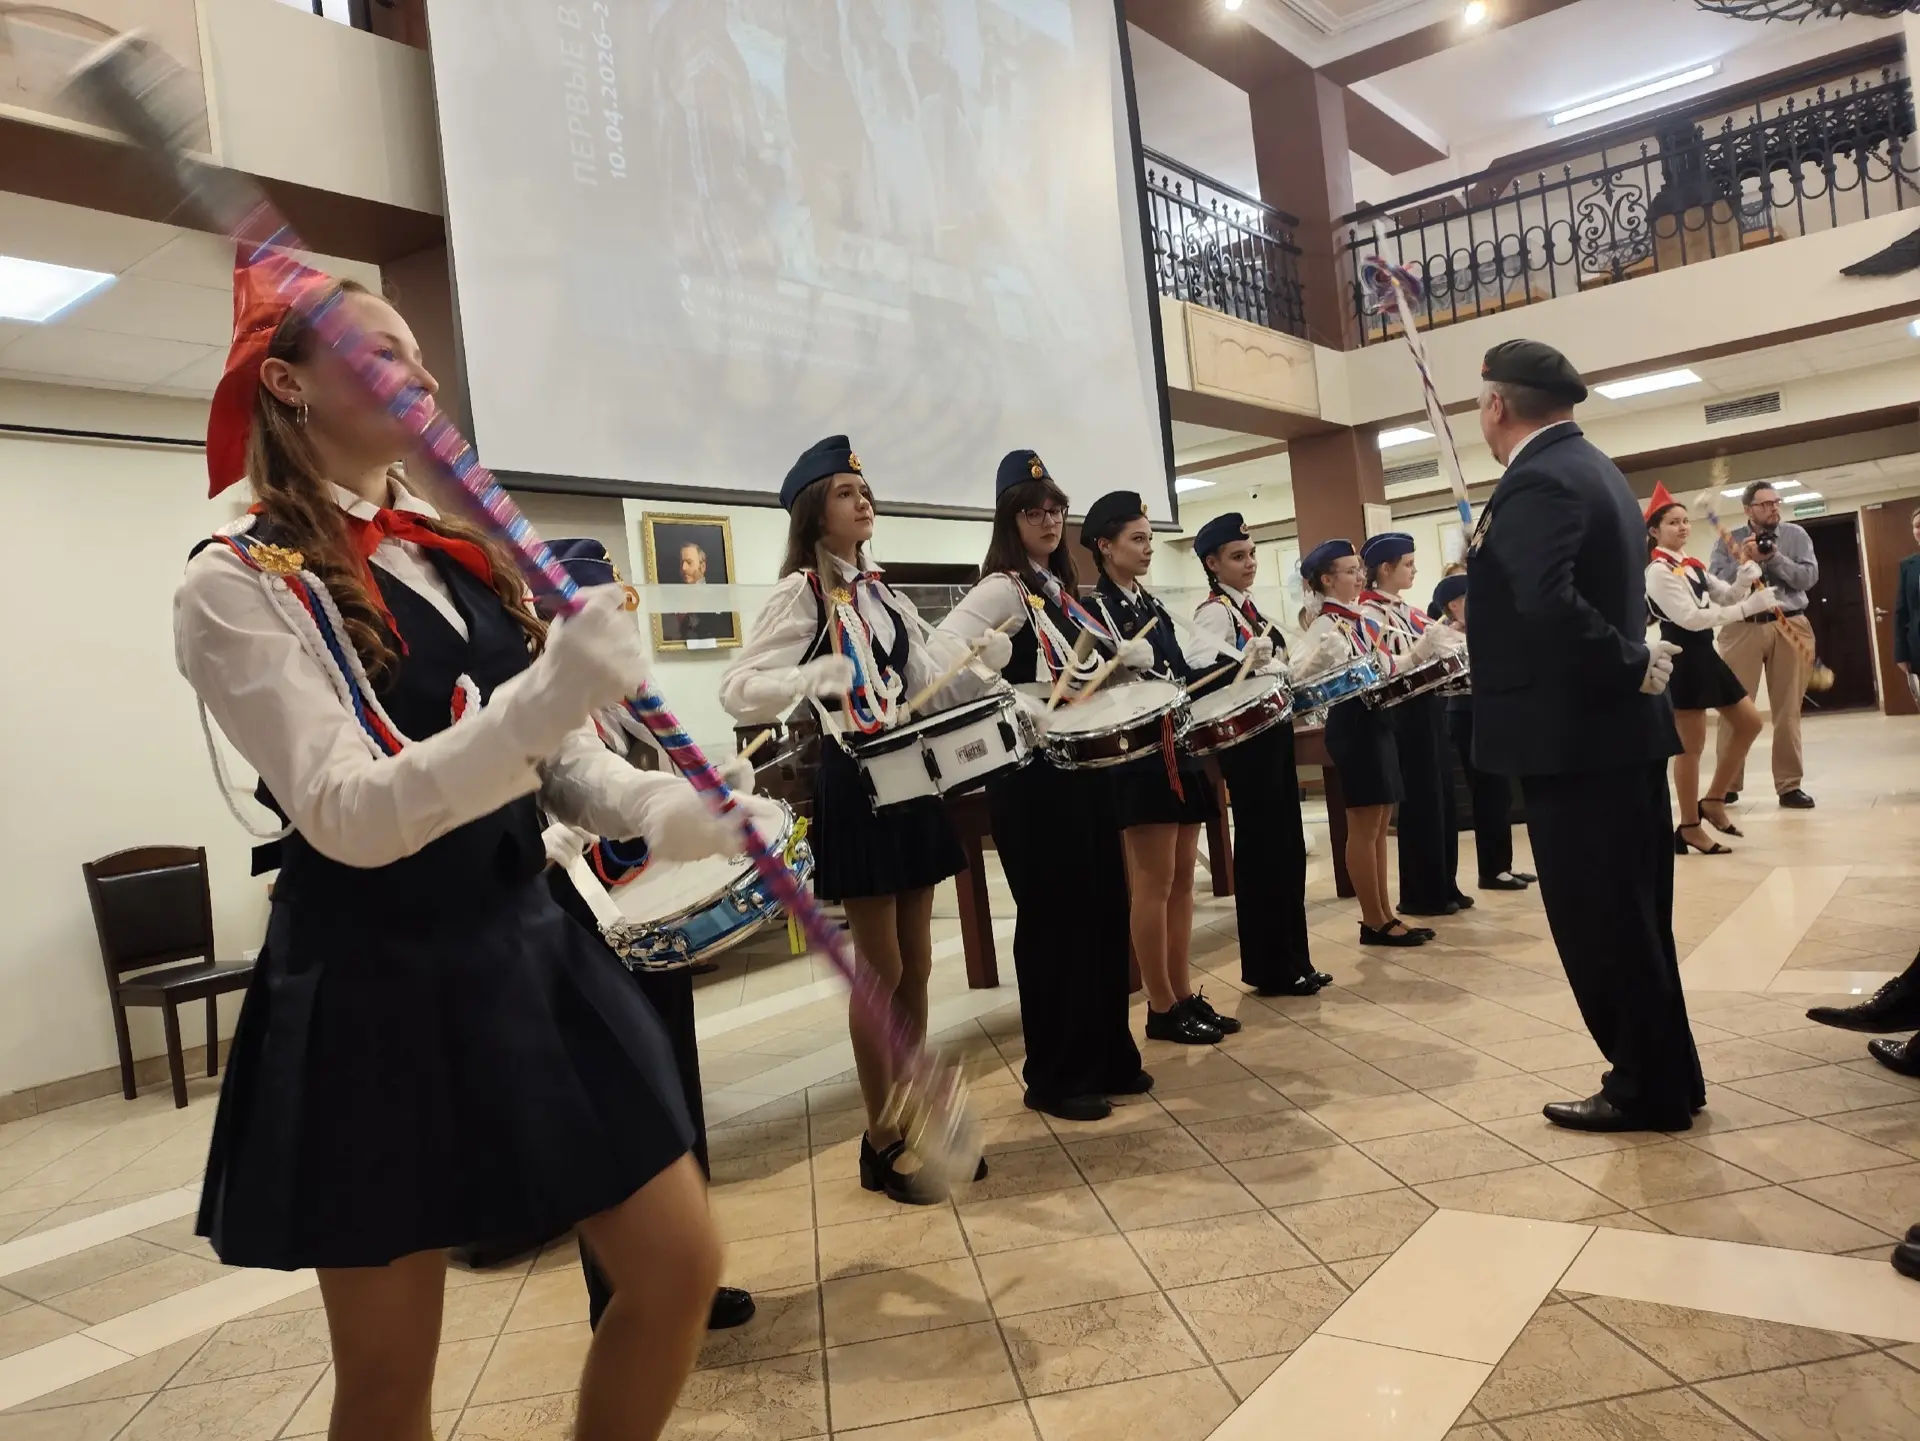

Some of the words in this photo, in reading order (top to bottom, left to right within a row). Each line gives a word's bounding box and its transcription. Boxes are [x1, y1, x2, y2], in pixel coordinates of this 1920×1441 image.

[557, 4, 582, 31] В
[560, 37, 598, 187] ПЕРВЫЕ
[957, 743, 983, 760] Flight
